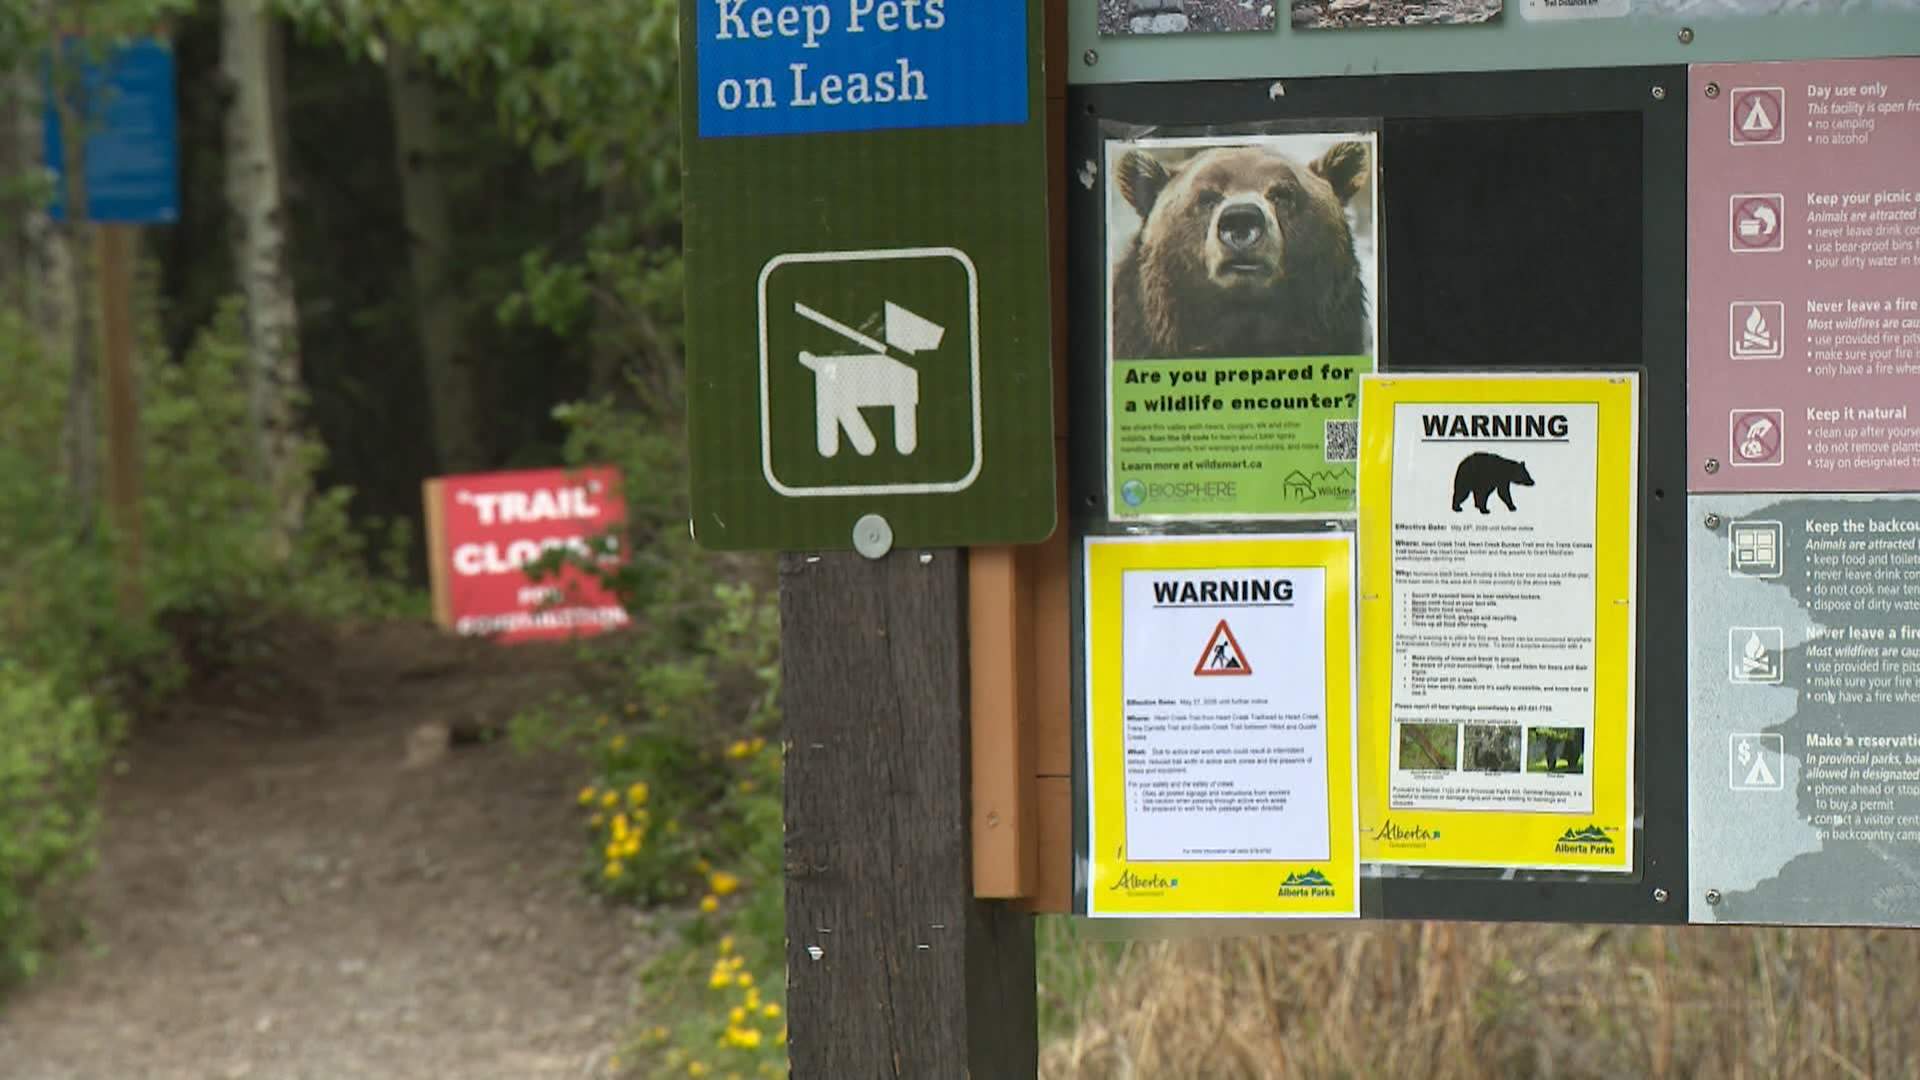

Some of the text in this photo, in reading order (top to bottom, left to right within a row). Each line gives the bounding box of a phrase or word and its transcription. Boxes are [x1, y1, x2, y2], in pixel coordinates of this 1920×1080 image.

[716, 0, 945, 48] Keep Pets
[717, 58, 928, 110] on Leash
[1808, 82, 1887, 99] Day use only
[1808, 101, 1904, 116] This facility is open
[1816, 118, 1874, 131] no camping
[1816, 133, 1868, 144] no alcohol
[1807, 190, 1910, 209] Keep your picnic
[1807, 208, 1916, 222] Animals are attracted
[1815, 224, 1901, 237] never leave drink
[1815, 239, 1912, 252] use bear-proof bins
[1815, 255, 1911, 270] pour dirty water in
[1807, 297, 1917, 312] Never leave a fire
[1807, 317, 1899, 329] Most wildfires are
[1815, 332, 1899, 347] use provided fire
[1815, 347, 1912, 362] make sure your fire
[1125, 364, 1353, 387] Are you prepared for
[1815, 362, 1893, 378] only have a fire
[1125, 393, 1356, 412] a wildlife encounter?
[1807, 406, 1906, 422] Keep it natural
[1422, 415, 1568, 438] WARNING
[1815, 428, 1841, 438] clean
[1845, 428, 1858, 439] up
[1861, 426, 1884, 437] after
[1815, 442, 1887, 453] do not remove
[1121, 460, 1262, 471] Learn more at wildsmart.ca
[1815, 456, 1909, 471] stay on designated
[1151, 481, 1237, 497] BIOSPHERE
[1806, 520, 1838, 535] Keep
[1843, 519, 1864, 532] the
[1806, 538, 1915, 550] Animals are attracted
[1814, 553, 1887, 566] keep food and
[1814, 568, 1901, 579] never leave drink
[1154, 580, 1293, 603] WARNING
[1814, 584, 1899, 595] do not cook near
[1814, 598, 1891, 612] dispose of dirty
[1806, 627, 1845, 640] Never
[1850, 626, 1884, 640] leave
[1889, 628, 1896, 639] a
[1806, 645, 1898, 657] Most wildfires are
[1814, 661, 1899, 674] use provided fire
[1814, 675, 1912, 690] make sure your fire
[1814, 691, 1836, 704] only
[1839, 691, 1863, 702] have
[1866, 693, 1872, 702] a
[1875, 691, 1892, 702] fire
[1807, 734, 1842, 747] Make
[1846, 737, 1854, 746] a
[1738, 739, 1750, 766] $
[1807, 752, 1901, 766] In provincial parks,
[1807, 767, 1919, 782] allowed in designated
[1815, 784, 1846, 796] phone
[1850, 783, 1881, 794] ahead
[1884, 785, 1894, 794] or
[1816, 799, 1894, 812] to buy a permit
[1815, 813, 1894, 825] contact a visitor
[1816, 828, 1893, 842] on backcountry
[1555, 843, 1615, 854] Alberta Parks
[1279, 887, 1335, 897] Alberta Parks
